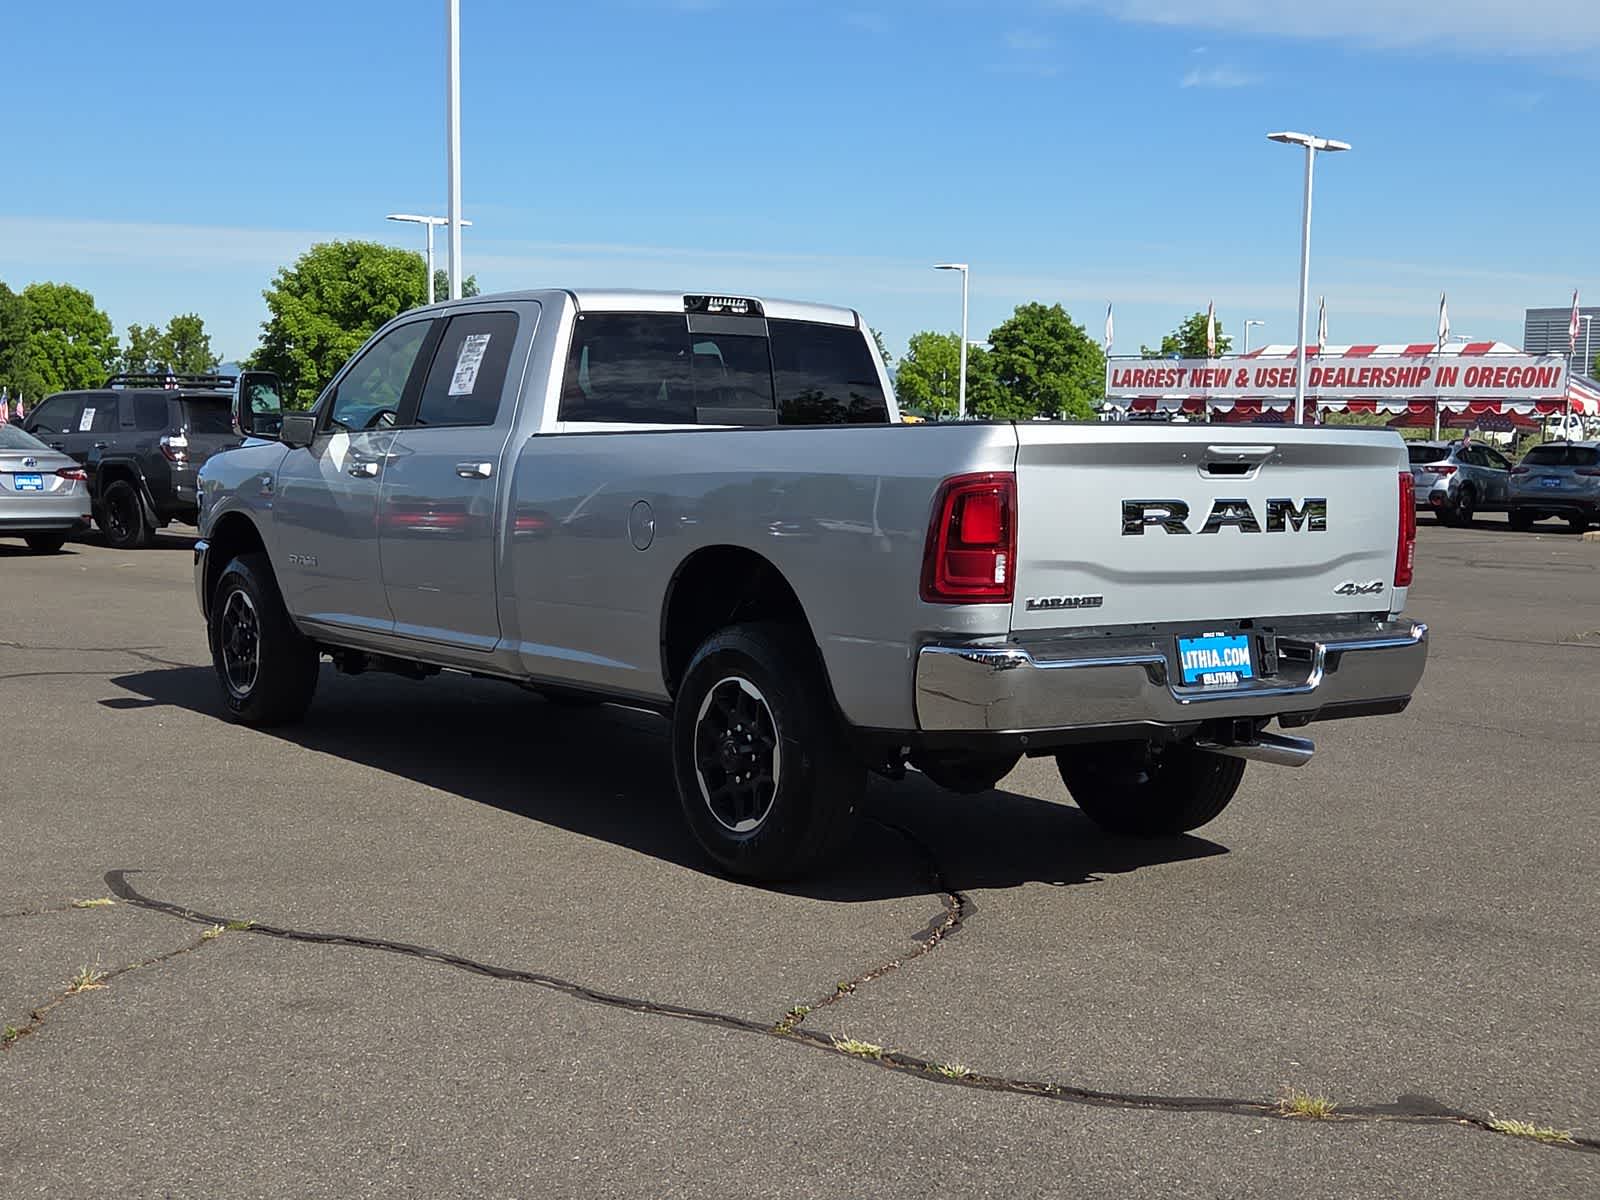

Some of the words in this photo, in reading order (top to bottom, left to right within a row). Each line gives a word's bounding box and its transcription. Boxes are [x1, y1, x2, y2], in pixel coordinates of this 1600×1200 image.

[1111, 368, 1187, 388] LARGEST
[1189, 368, 1232, 388] NEW
[1234, 367, 1250, 388] &
[1308, 366, 1431, 388] DEALERSHIP
[1434, 366, 1458, 388] IN
[1463, 366, 1561, 388] OREGON!
[1121, 498, 1327, 536] RAM
[1181, 647, 1251, 670] LITHIA.COM
